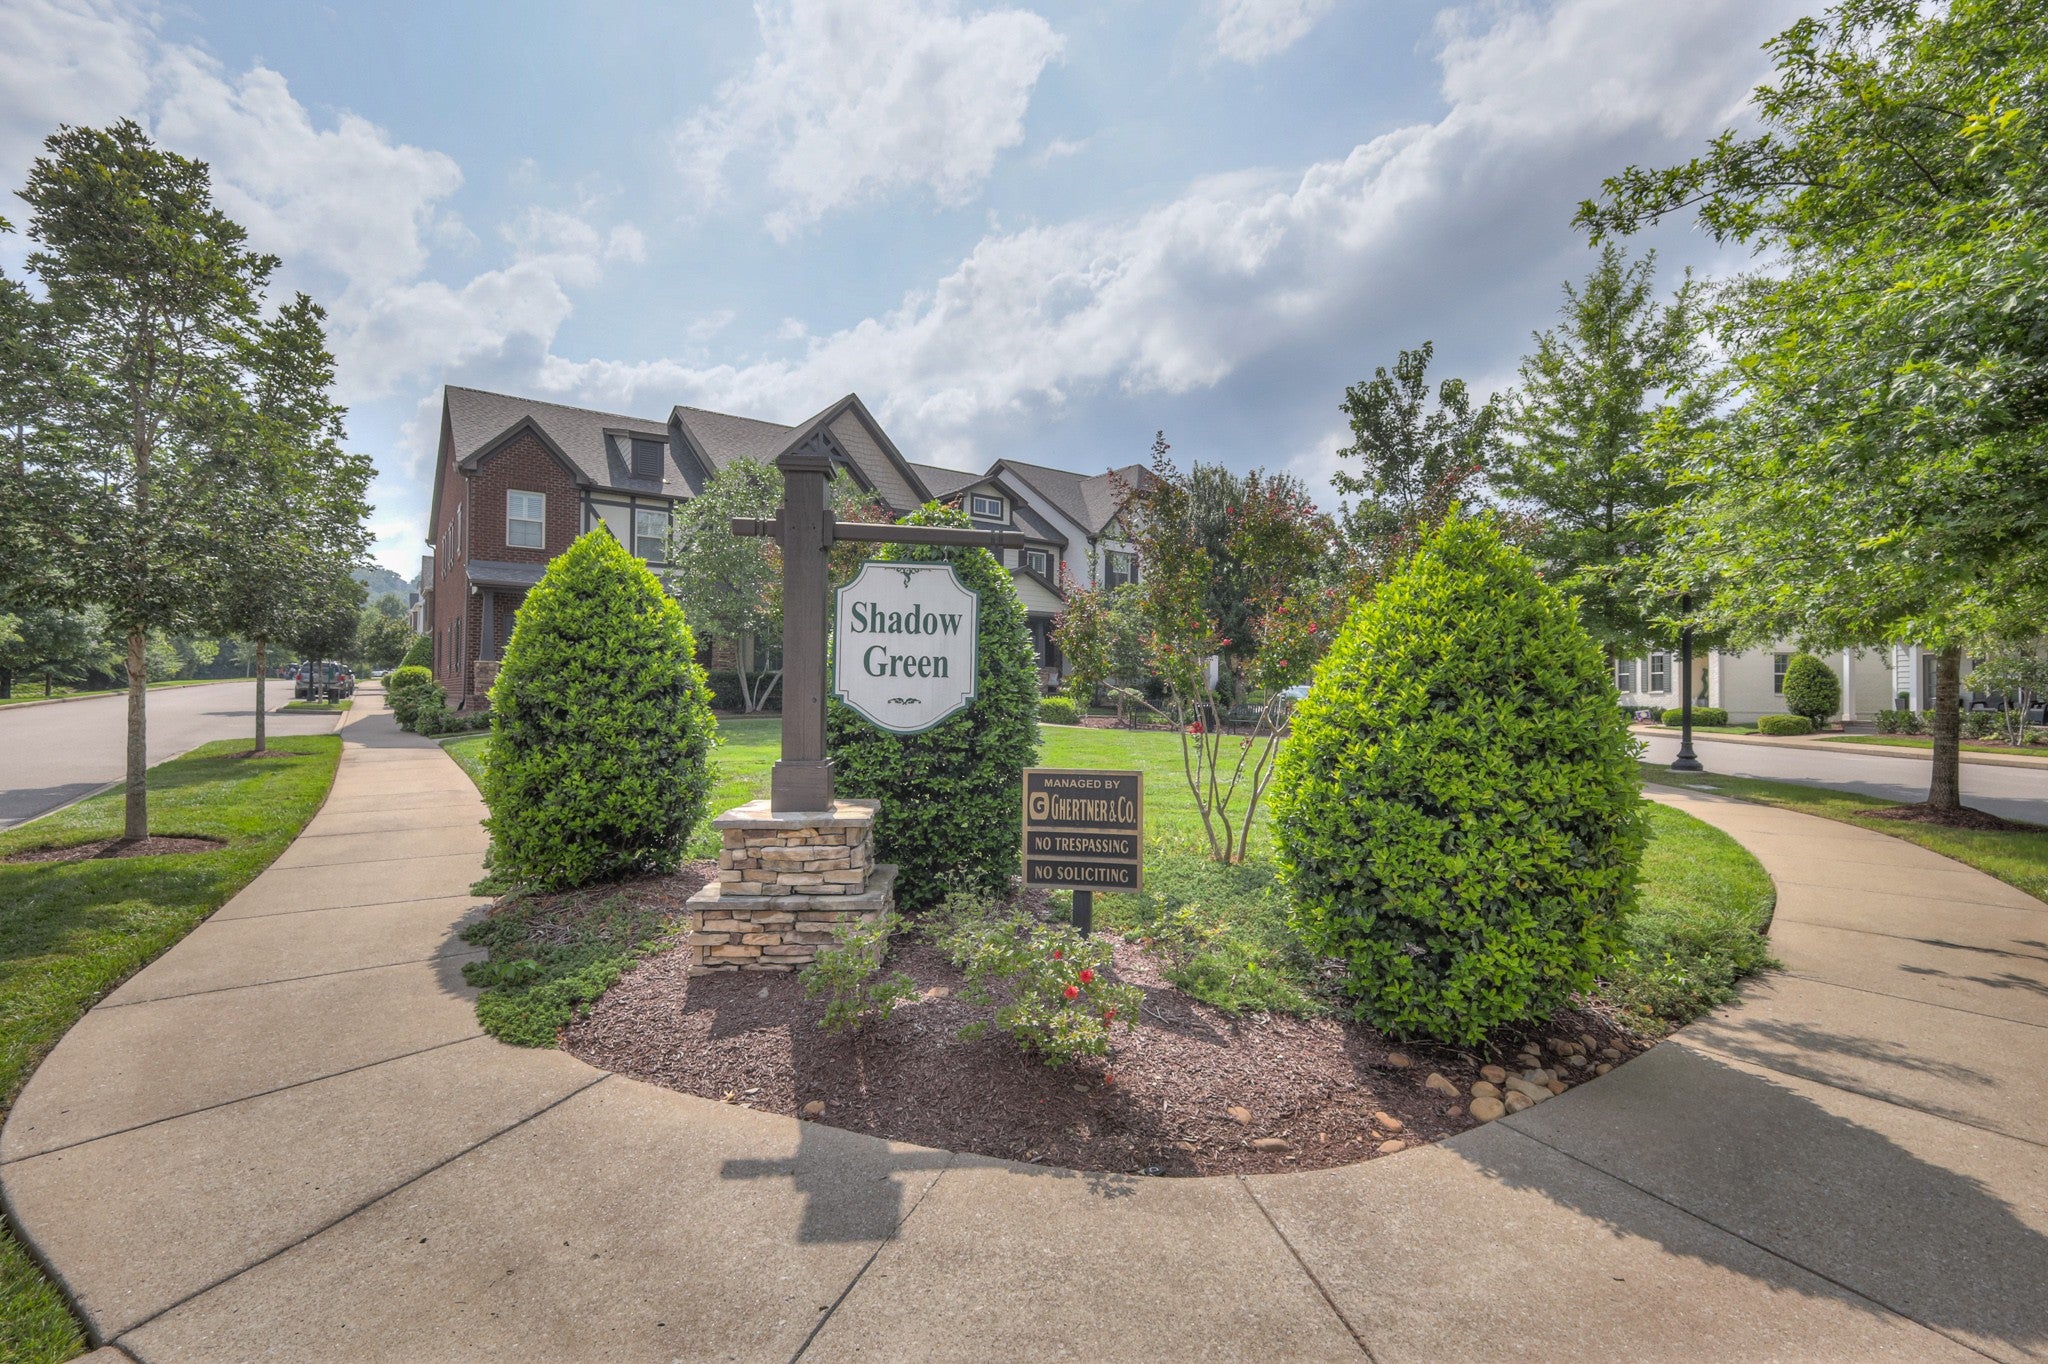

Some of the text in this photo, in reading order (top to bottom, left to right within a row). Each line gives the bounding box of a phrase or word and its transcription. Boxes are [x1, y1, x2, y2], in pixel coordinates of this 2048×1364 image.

[850, 601, 963, 636] Shadow
[863, 645, 949, 678] Green
[1044, 779, 1120, 789] MANAGED BY
[1035, 837, 1129, 854] NO TRESPASSING
[1034, 866, 1129, 883] NO SOLICITING
